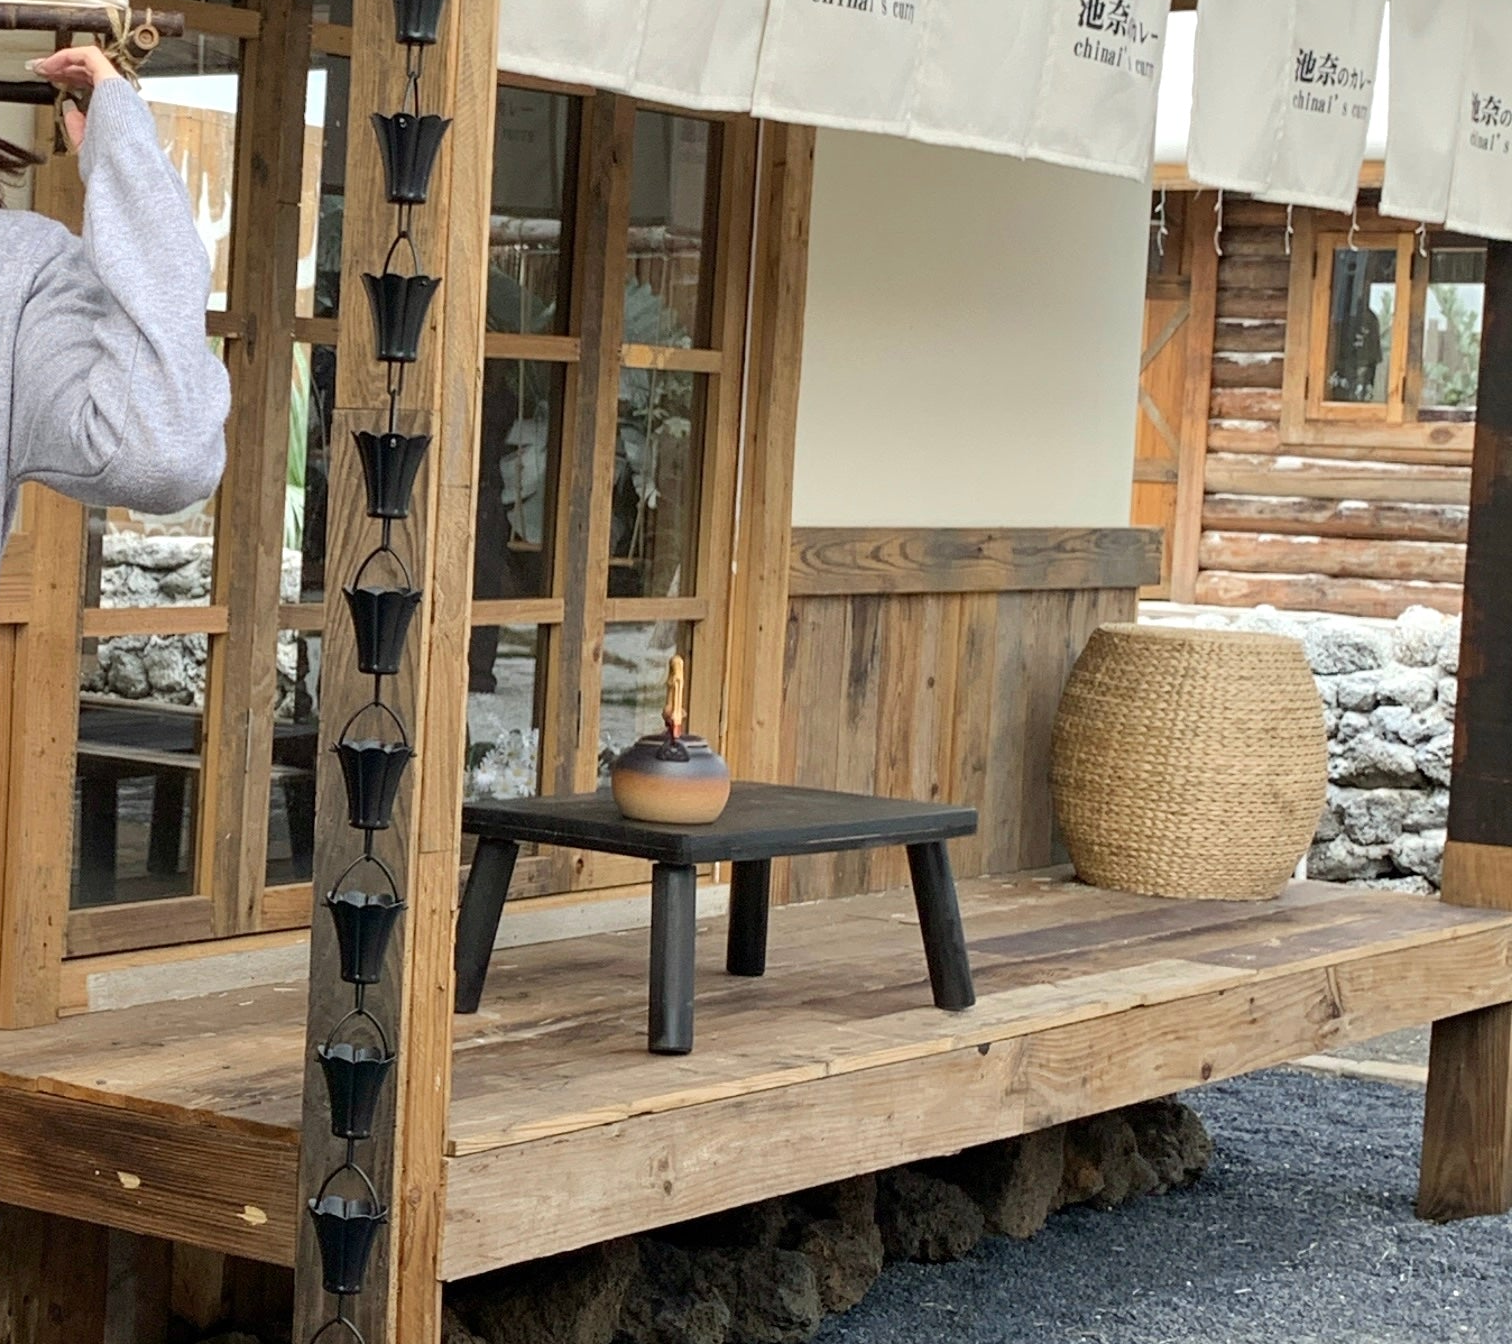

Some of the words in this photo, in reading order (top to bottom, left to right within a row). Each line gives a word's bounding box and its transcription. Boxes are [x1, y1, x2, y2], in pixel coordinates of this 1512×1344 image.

[1073, 36, 1132, 73] chinai'
[1293, 48, 1372, 91] 池奈のカレー
